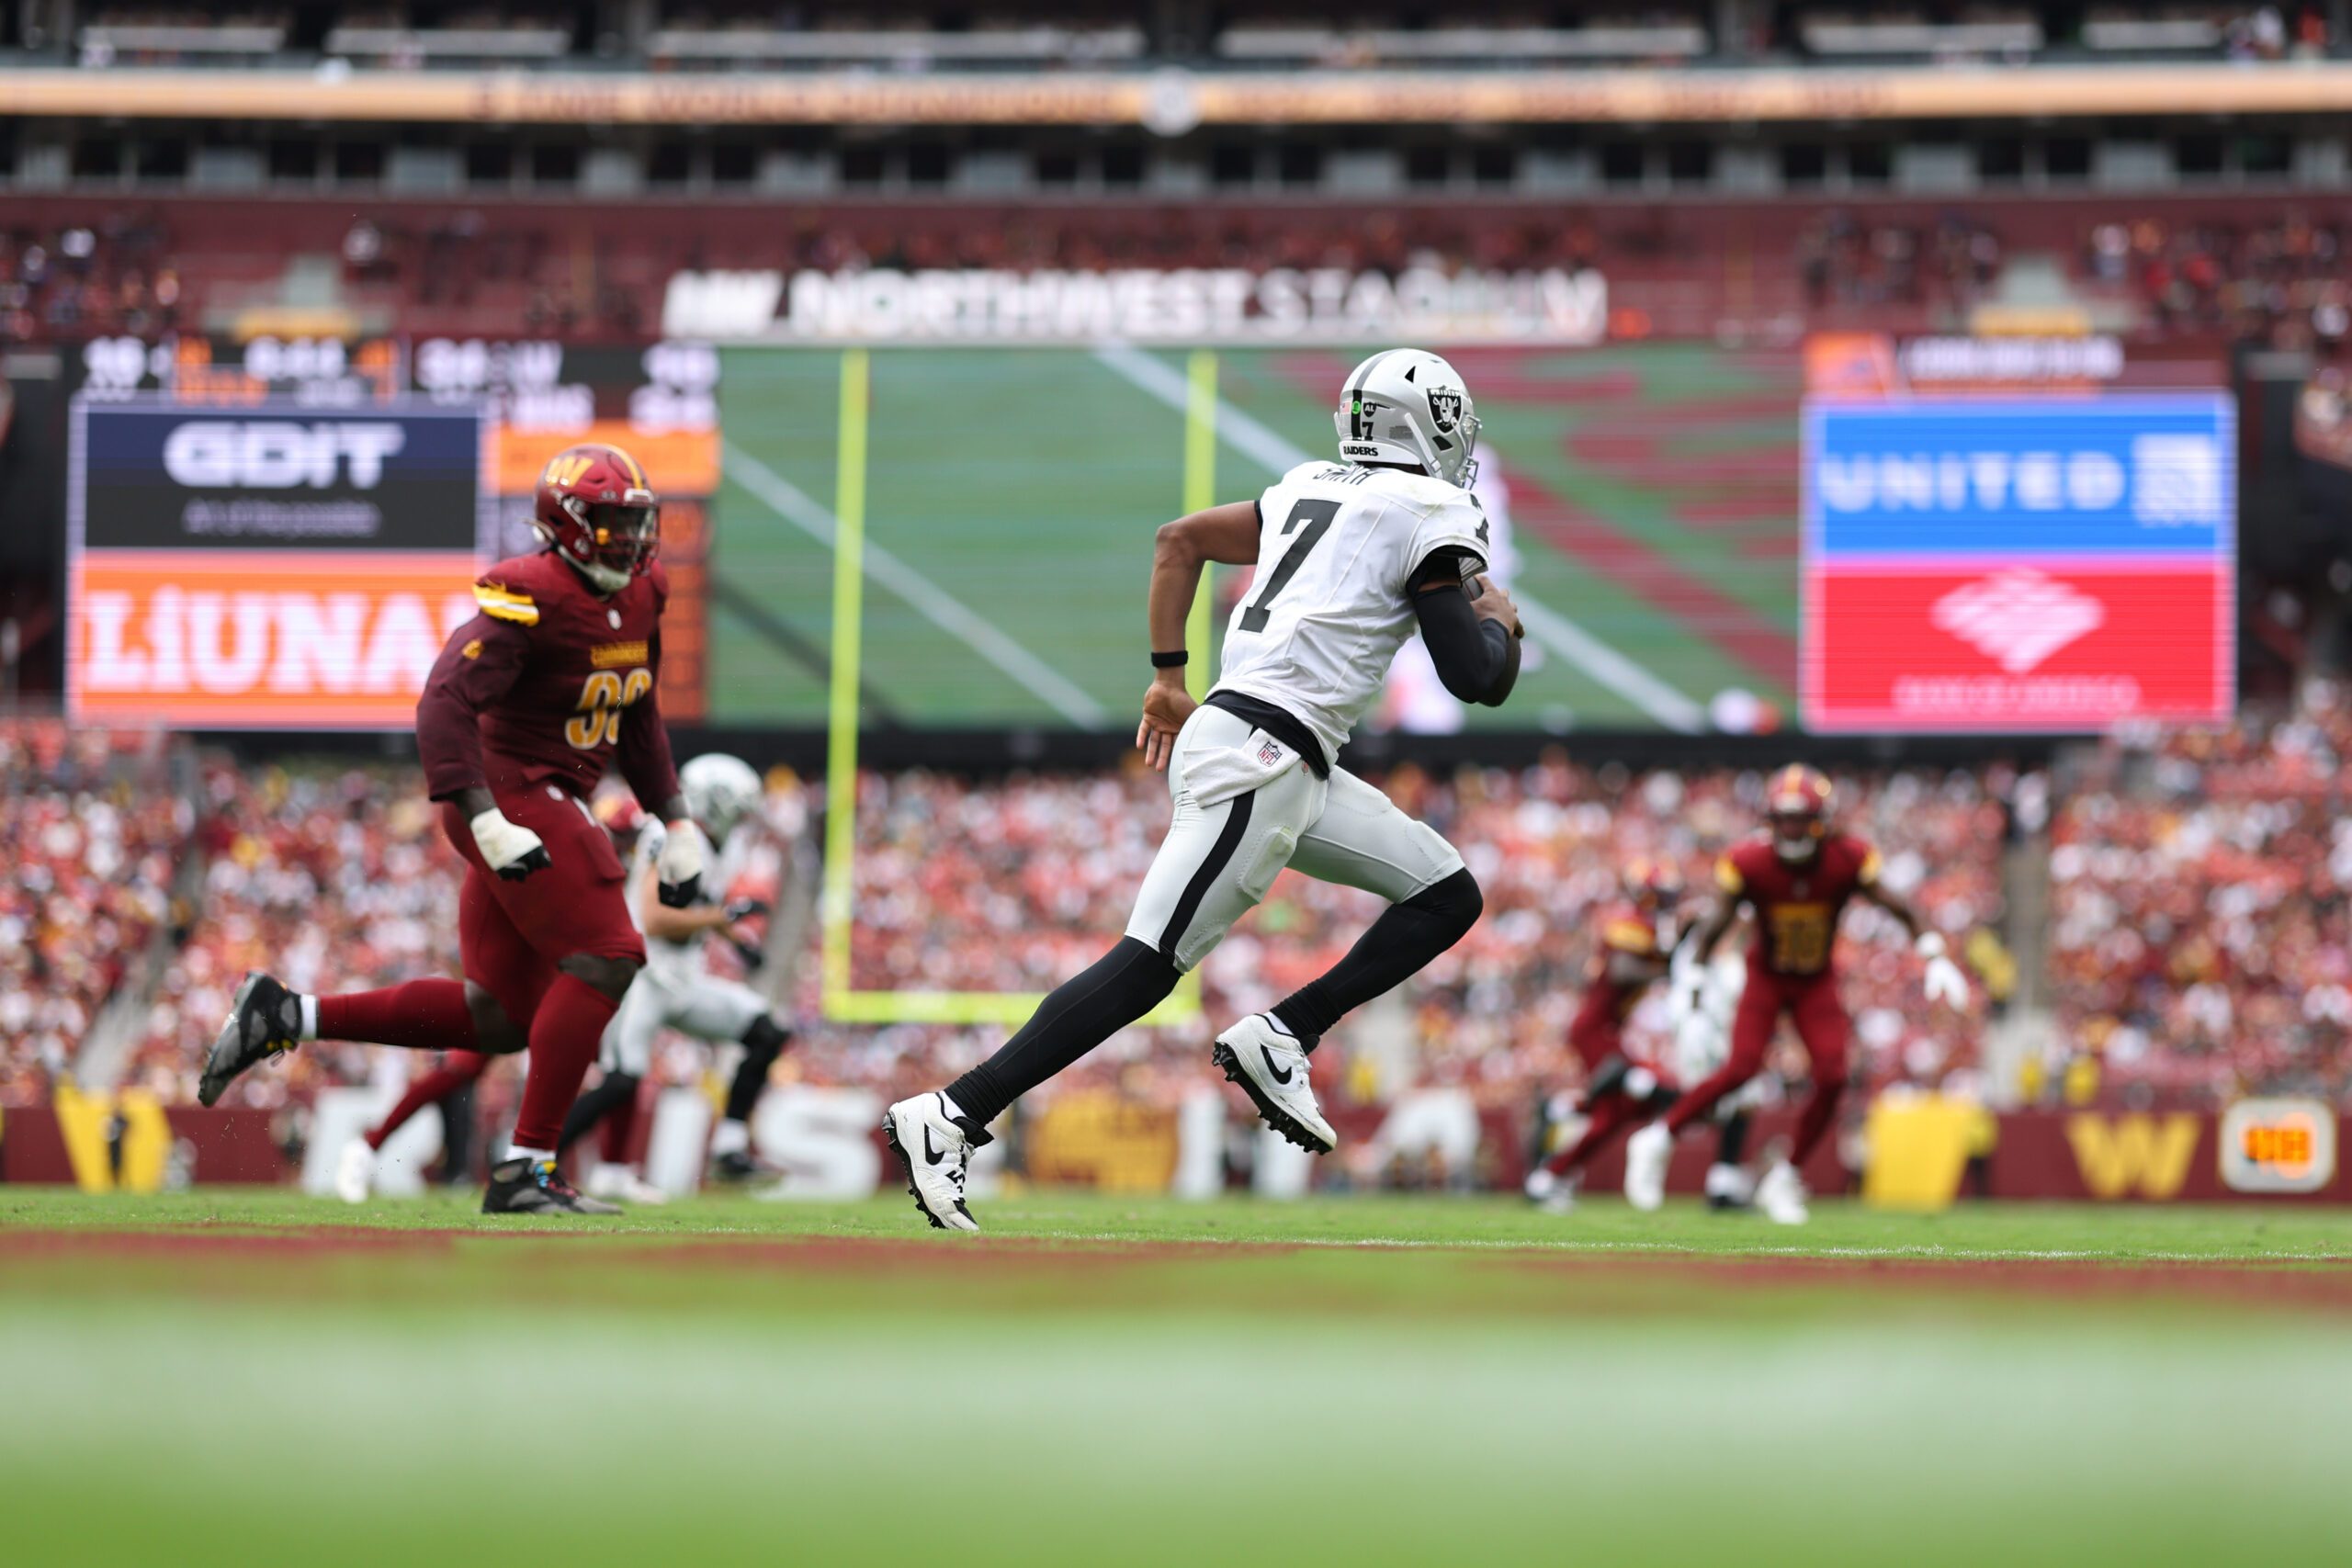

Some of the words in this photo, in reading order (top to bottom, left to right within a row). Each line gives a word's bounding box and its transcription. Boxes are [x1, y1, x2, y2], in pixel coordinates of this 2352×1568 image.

[788, 269, 1250, 337] NORTHWEST
[1362, 422, 1374, 441] 7
[1364, 404, 1375, 412] AL
[164, 422, 406, 490] GDIT
[1819, 451, 2125, 513] UNITED
[1238, 499, 1343, 634] 7
[1259, 749, 1274, 765] NFL
[2065, 1113, 2202, 1197] W
